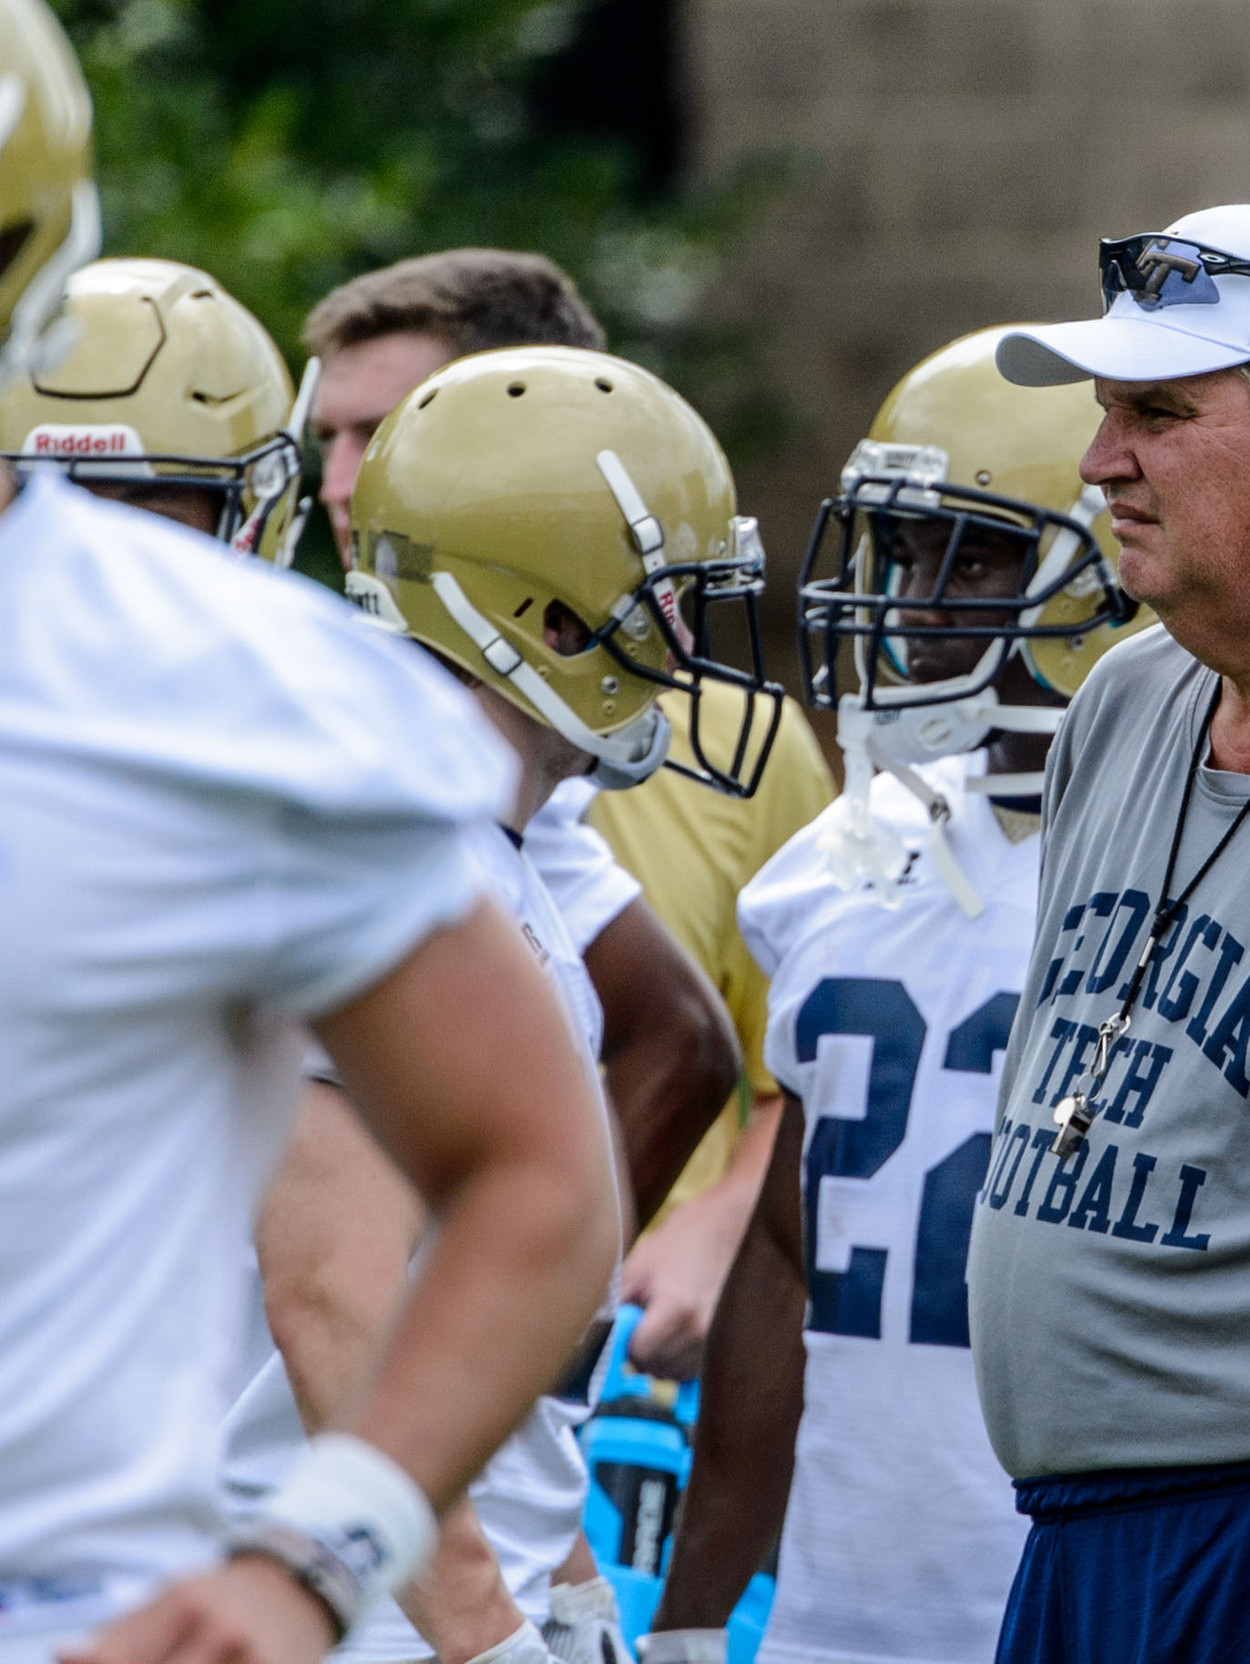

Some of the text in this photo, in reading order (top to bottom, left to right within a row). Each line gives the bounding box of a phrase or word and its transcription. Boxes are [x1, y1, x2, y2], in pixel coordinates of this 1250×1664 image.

[35, 432, 127, 453] Riddell
[1031, 1017, 1174, 1129] TECH
[980, 1116, 1211, 1251] OTBALL
